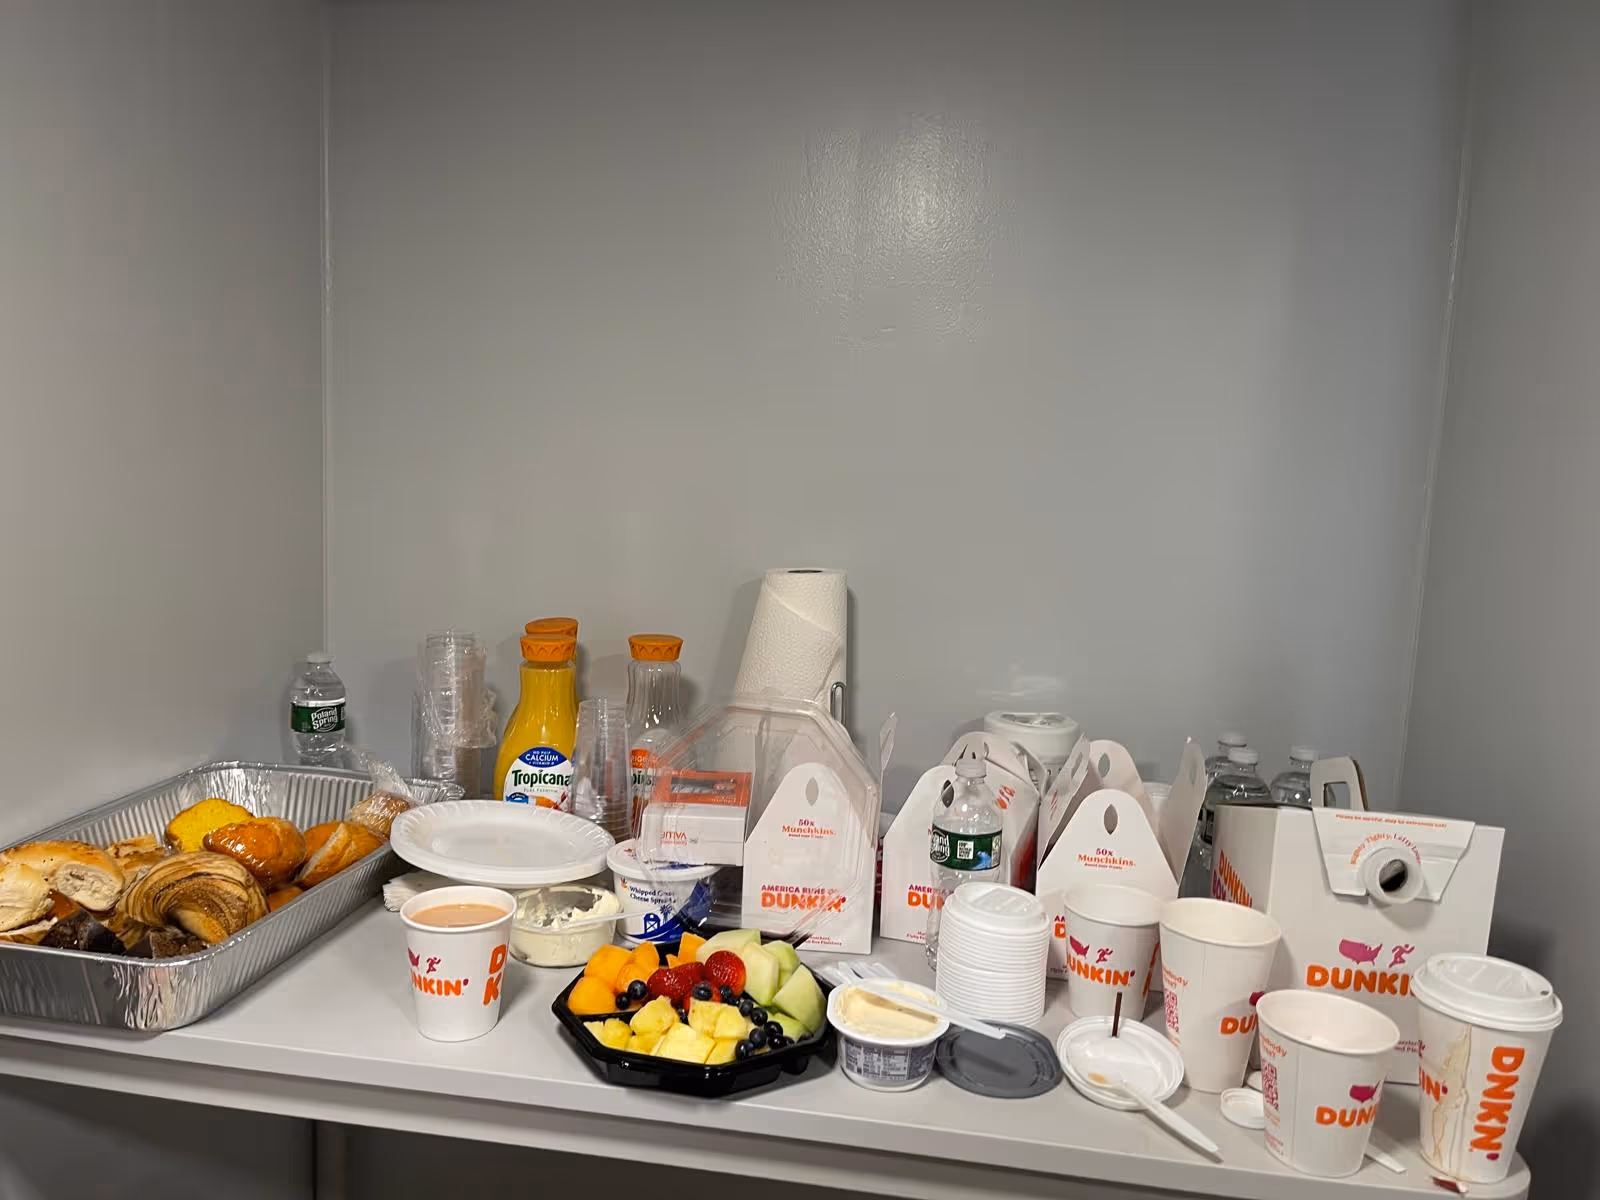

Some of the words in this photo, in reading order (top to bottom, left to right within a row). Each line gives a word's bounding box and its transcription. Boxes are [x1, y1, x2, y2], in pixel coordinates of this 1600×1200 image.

[311, 707, 338, 721] Poland
[312, 715, 338, 730] Spring
[525, 754, 559, 762] CALCIUM
[512, 769, 571, 788] Tropicana
[1096, 848, 1114, 856] 50x
[630, 885, 656, 896] Whipped
[761, 884, 801, 893] AMERICA
[1067, 953, 1136, 986] UNKIN'
[411, 971, 469, 997] NKIN'
[1306, 964, 1416, 997] DUNKI
[1315, 1104, 1377, 1128] DUN
